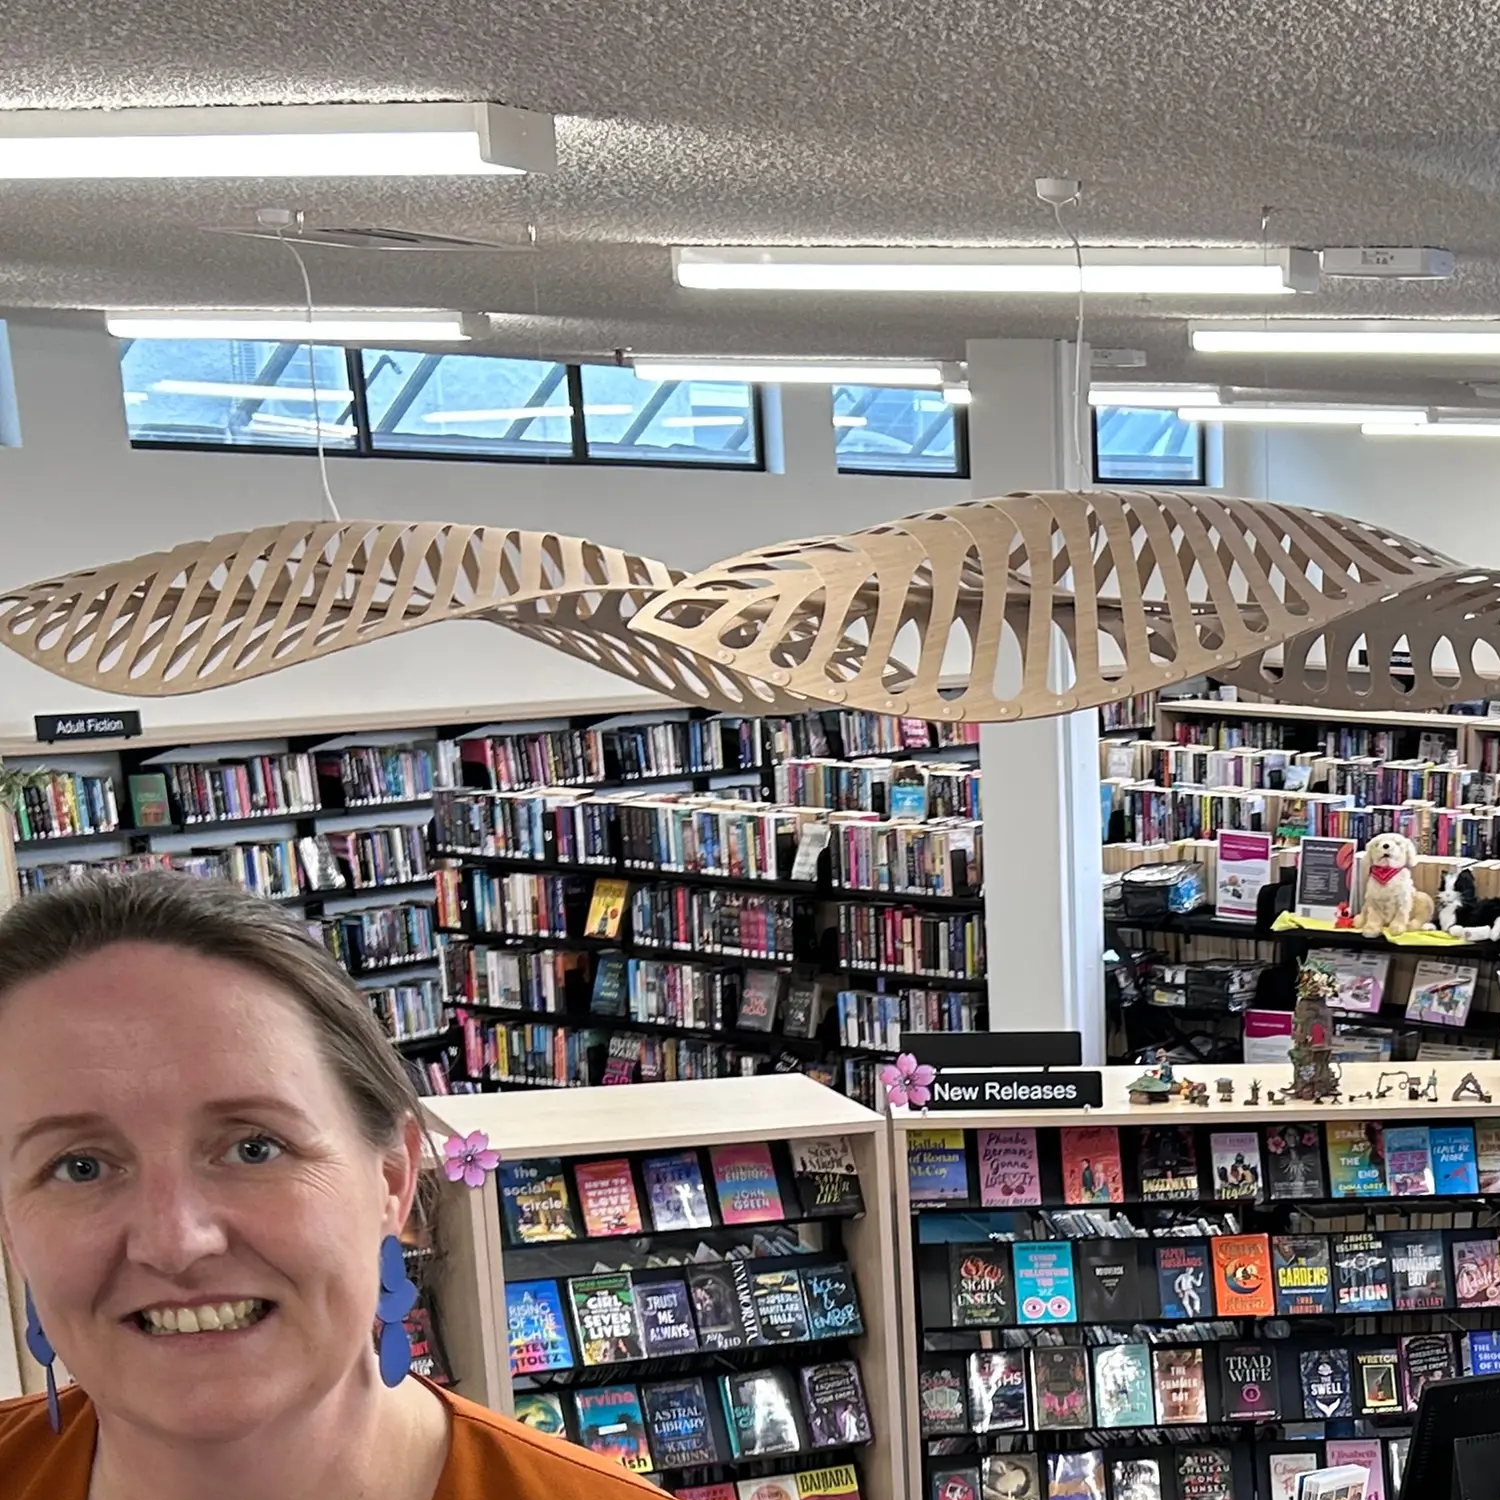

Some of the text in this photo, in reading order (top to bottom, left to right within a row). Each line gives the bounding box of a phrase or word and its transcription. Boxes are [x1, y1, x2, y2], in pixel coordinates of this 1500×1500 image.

[56, 718, 124, 734] Adult Fiction
[934, 1081, 1077, 1101] New Releases
[990, 1160, 1029, 1175] Gonna
[1340, 1156, 1360, 1165] THE
[514, 1166, 537, 1179] the
[910, 1166, 948, 1178] McCoy
[1358, 1169, 1379, 1179] END
[503, 1183, 547, 1197] social
[734, 1188, 766, 1200] JOHN
[522, 1197, 562, 1212] circle
[588, 1193, 630, 1208] LOVE
[732, 1198, 770, 1212] GREEN
[1343, 1233, 1374, 1243] JAMES
[1336, 1240, 1382, 1253] ISLINGTON
[1407, 1244, 1424, 1257] THE
[1392, 1255, 1443, 1273] NOWHERE
[1278, 1267, 1329, 1287] GARDENS
[1408, 1271, 1428, 1287] BOY
[957, 1291, 1006, 1307] UNSEEN
[1339, 1284, 1388, 1304] SCION
[508, 1302, 551, 1315] RISING
[586, 1294, 622, 1310] GIRL
[647, 1293, 678, 1311] TRUST
[509, 1315, 557, 1330] OF THE
[583, 1312, 631, 1329] SEVEN
[657, 1310, 675, 1325] ME
[590, 1326, 631, 1340] LIVES
[650, 1324, 690, 1342] ALWAYS
[1473, 1344, 1490, 1352] THE
[1225, 1355, 1272, 1370] TRAD
[1480, 1361, 1492, 1370] OF
[1228, 1368, 1272, 1383] WIFE
[1310, 1382, 1344, 1397] SWELL
[655, 1406, 702, 1421] ASTRAL
[654, 1417, 706, 1434] LIBRARY
[621, 1455, 648, 1469] lsh
[665, 1449, 710, 1465] QUINN
[1179, 1464, 1230, 1475] CHATEAU
[1184, 1484, 1227, 1494] SUNSET
